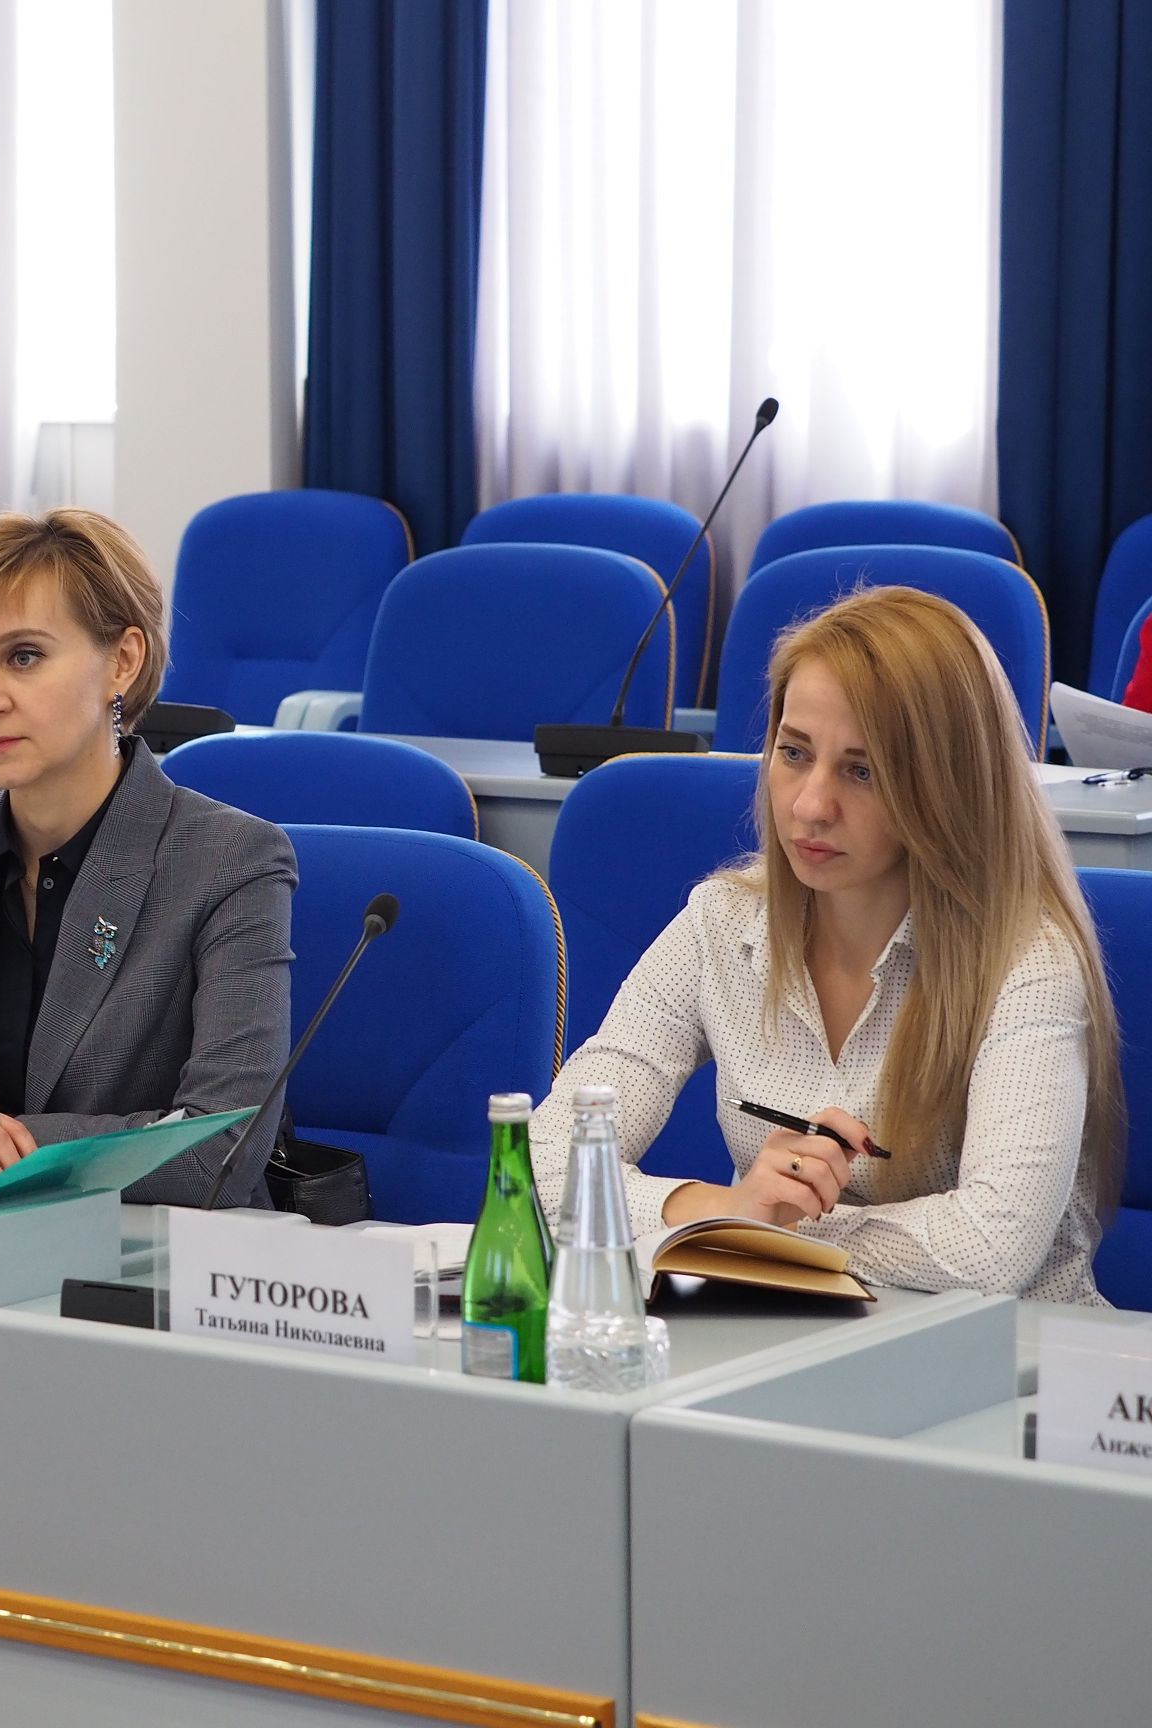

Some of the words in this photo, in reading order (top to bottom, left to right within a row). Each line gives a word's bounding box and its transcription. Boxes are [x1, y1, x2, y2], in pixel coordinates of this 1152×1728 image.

[209, 1272, 370, 1319] ГУТОРОВА
[195, 1307, 269, 1336] Татьяна
[275, 1319, 385, 1352] Николаевна
